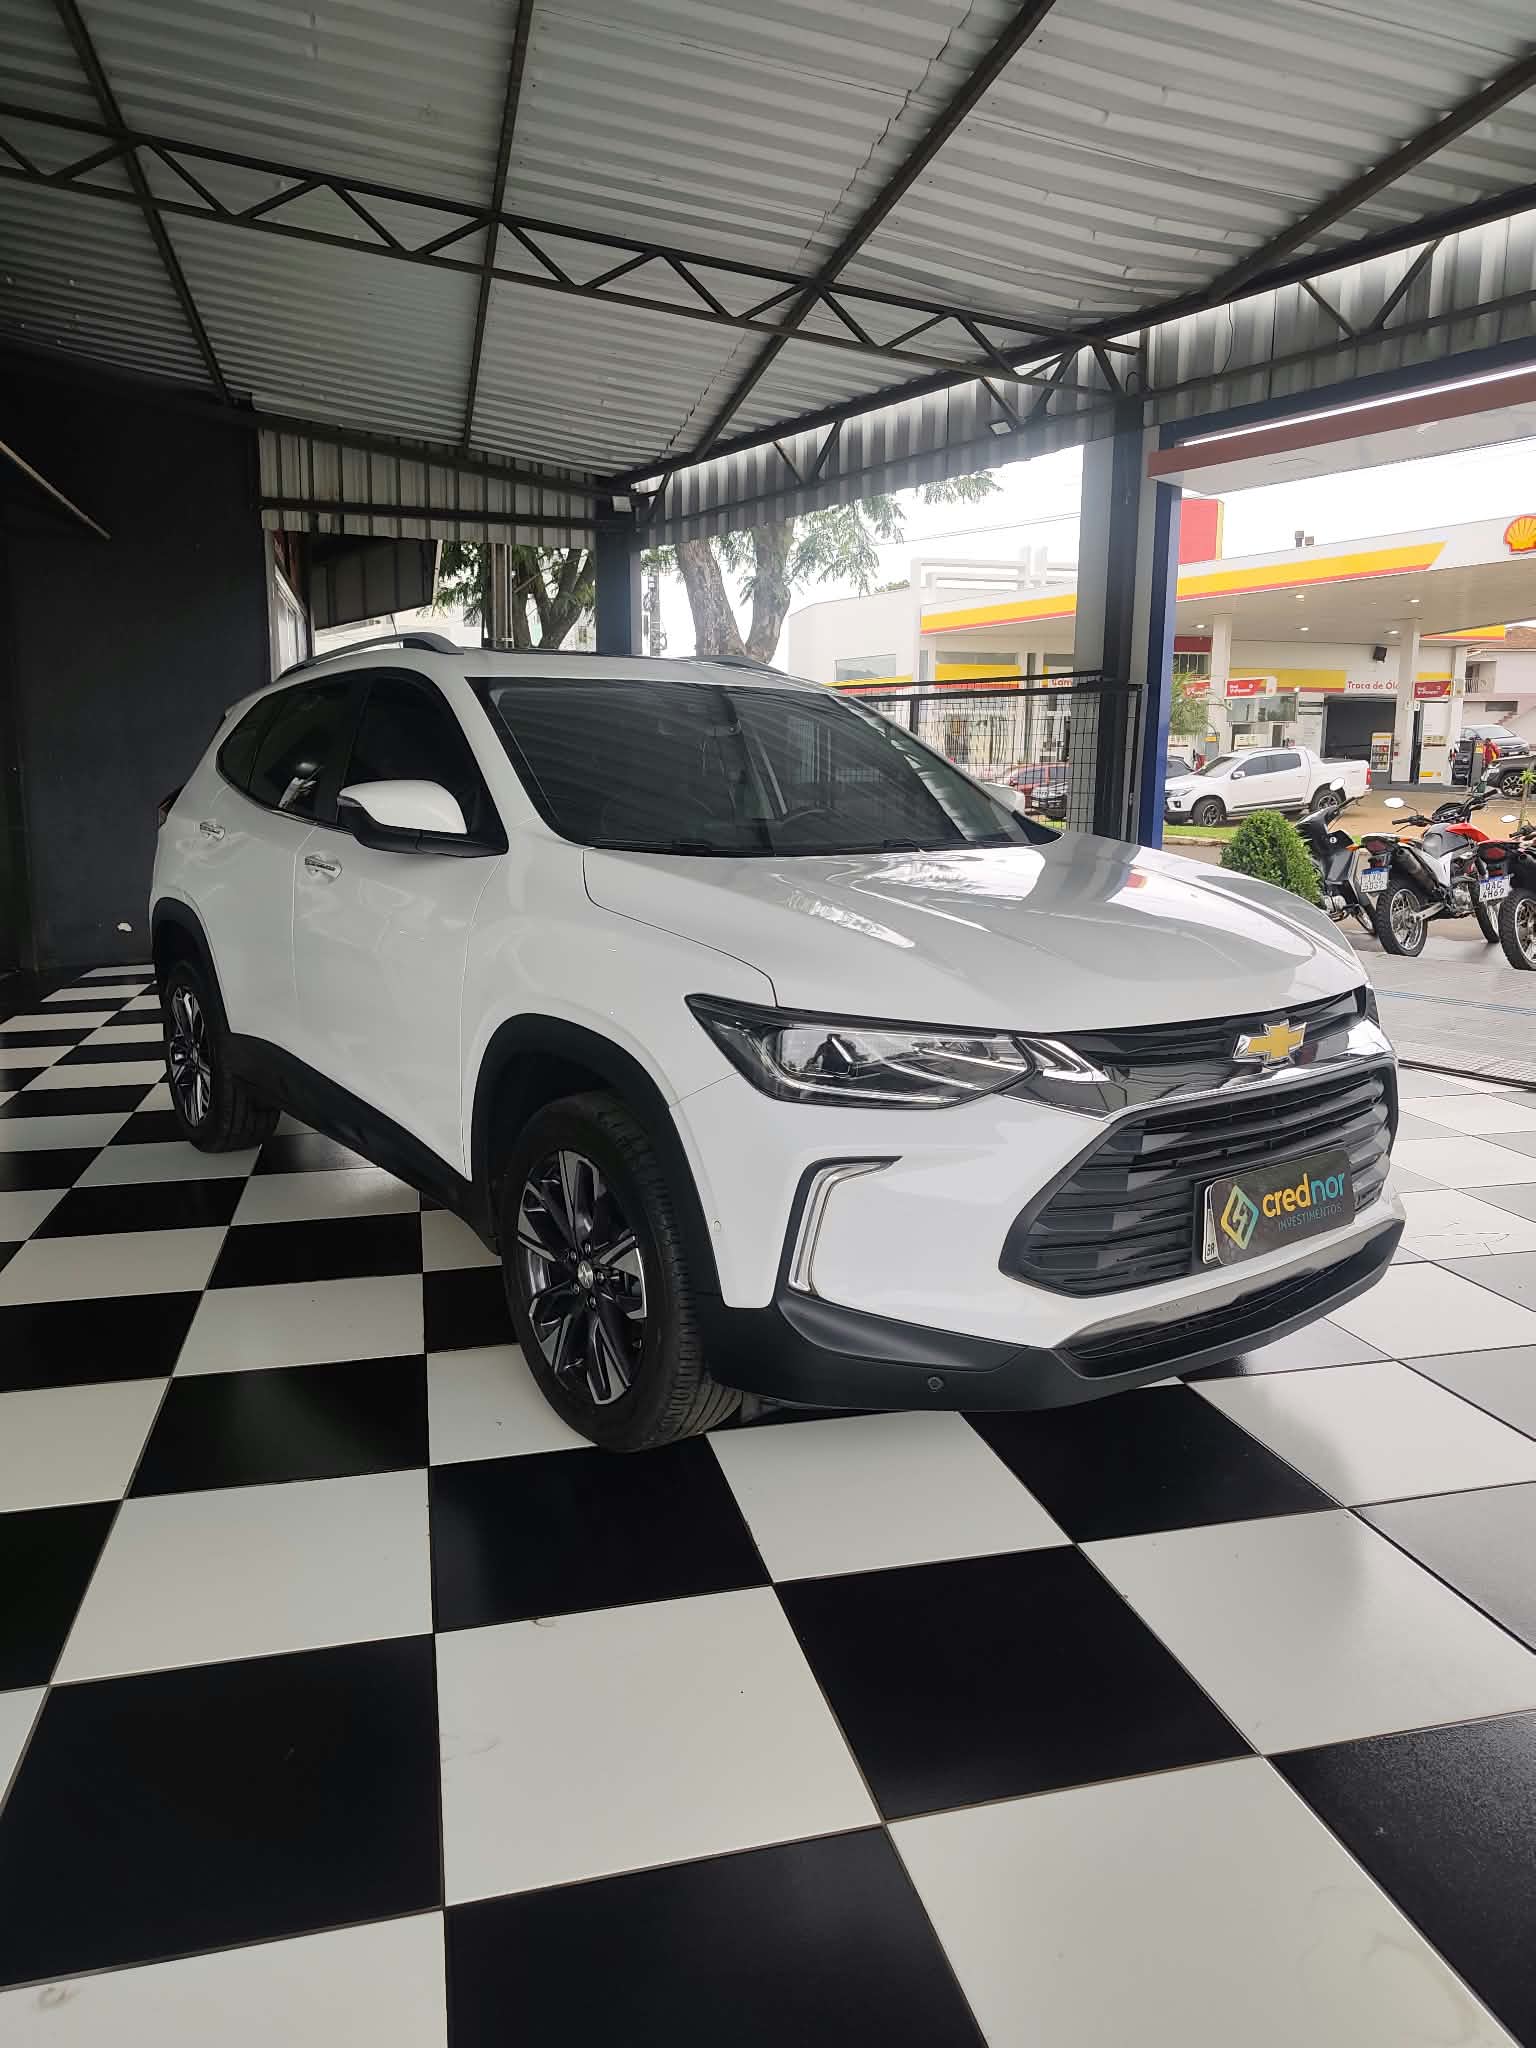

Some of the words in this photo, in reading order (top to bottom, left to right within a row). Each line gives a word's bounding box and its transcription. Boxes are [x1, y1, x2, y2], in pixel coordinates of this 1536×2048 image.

[1348, 681, 1370, 690] Troca
[1372, 681, 1384, 690] de
[1262, 1172, 1345, 1218] crednor
[1278, 1204, 1343, 1232] INVESTIMENTOS
